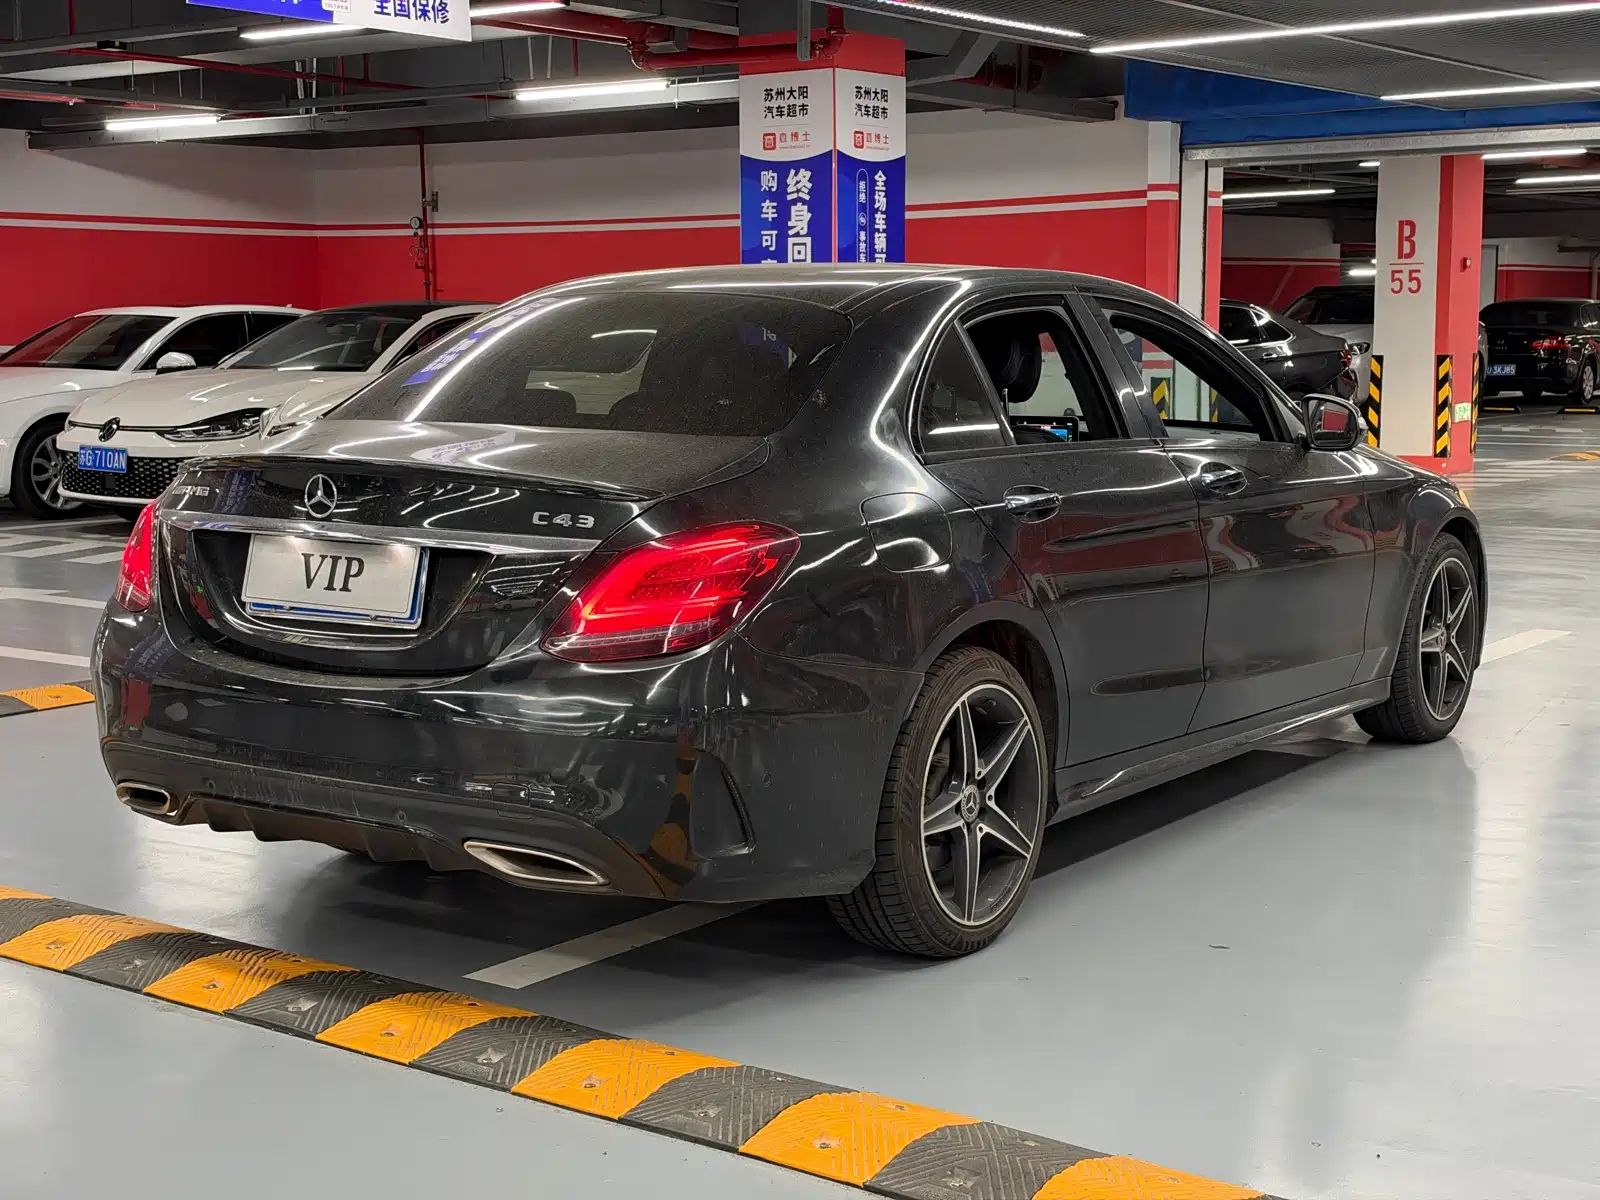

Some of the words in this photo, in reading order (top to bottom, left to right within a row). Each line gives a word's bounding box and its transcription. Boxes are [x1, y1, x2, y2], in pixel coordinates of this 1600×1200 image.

[374, 0, 449, 24] 全国保修
[763, 85, 809, 102] 苏州大阳
[854, 85, 888, 103] 苏州大阳
[763, 102, 809, 119] 汽车超市
[854, 102, 888, 120] 汽车超市
[760, 169, 778, 263] 购车可
[786, 168, 813, 263] 终身回
[1397, 219, 1417, 260] B
[1390, 269, 1422, 295] 55
[532, 511, 595, 529] C43
[301, 553, 365, 593] VIP
